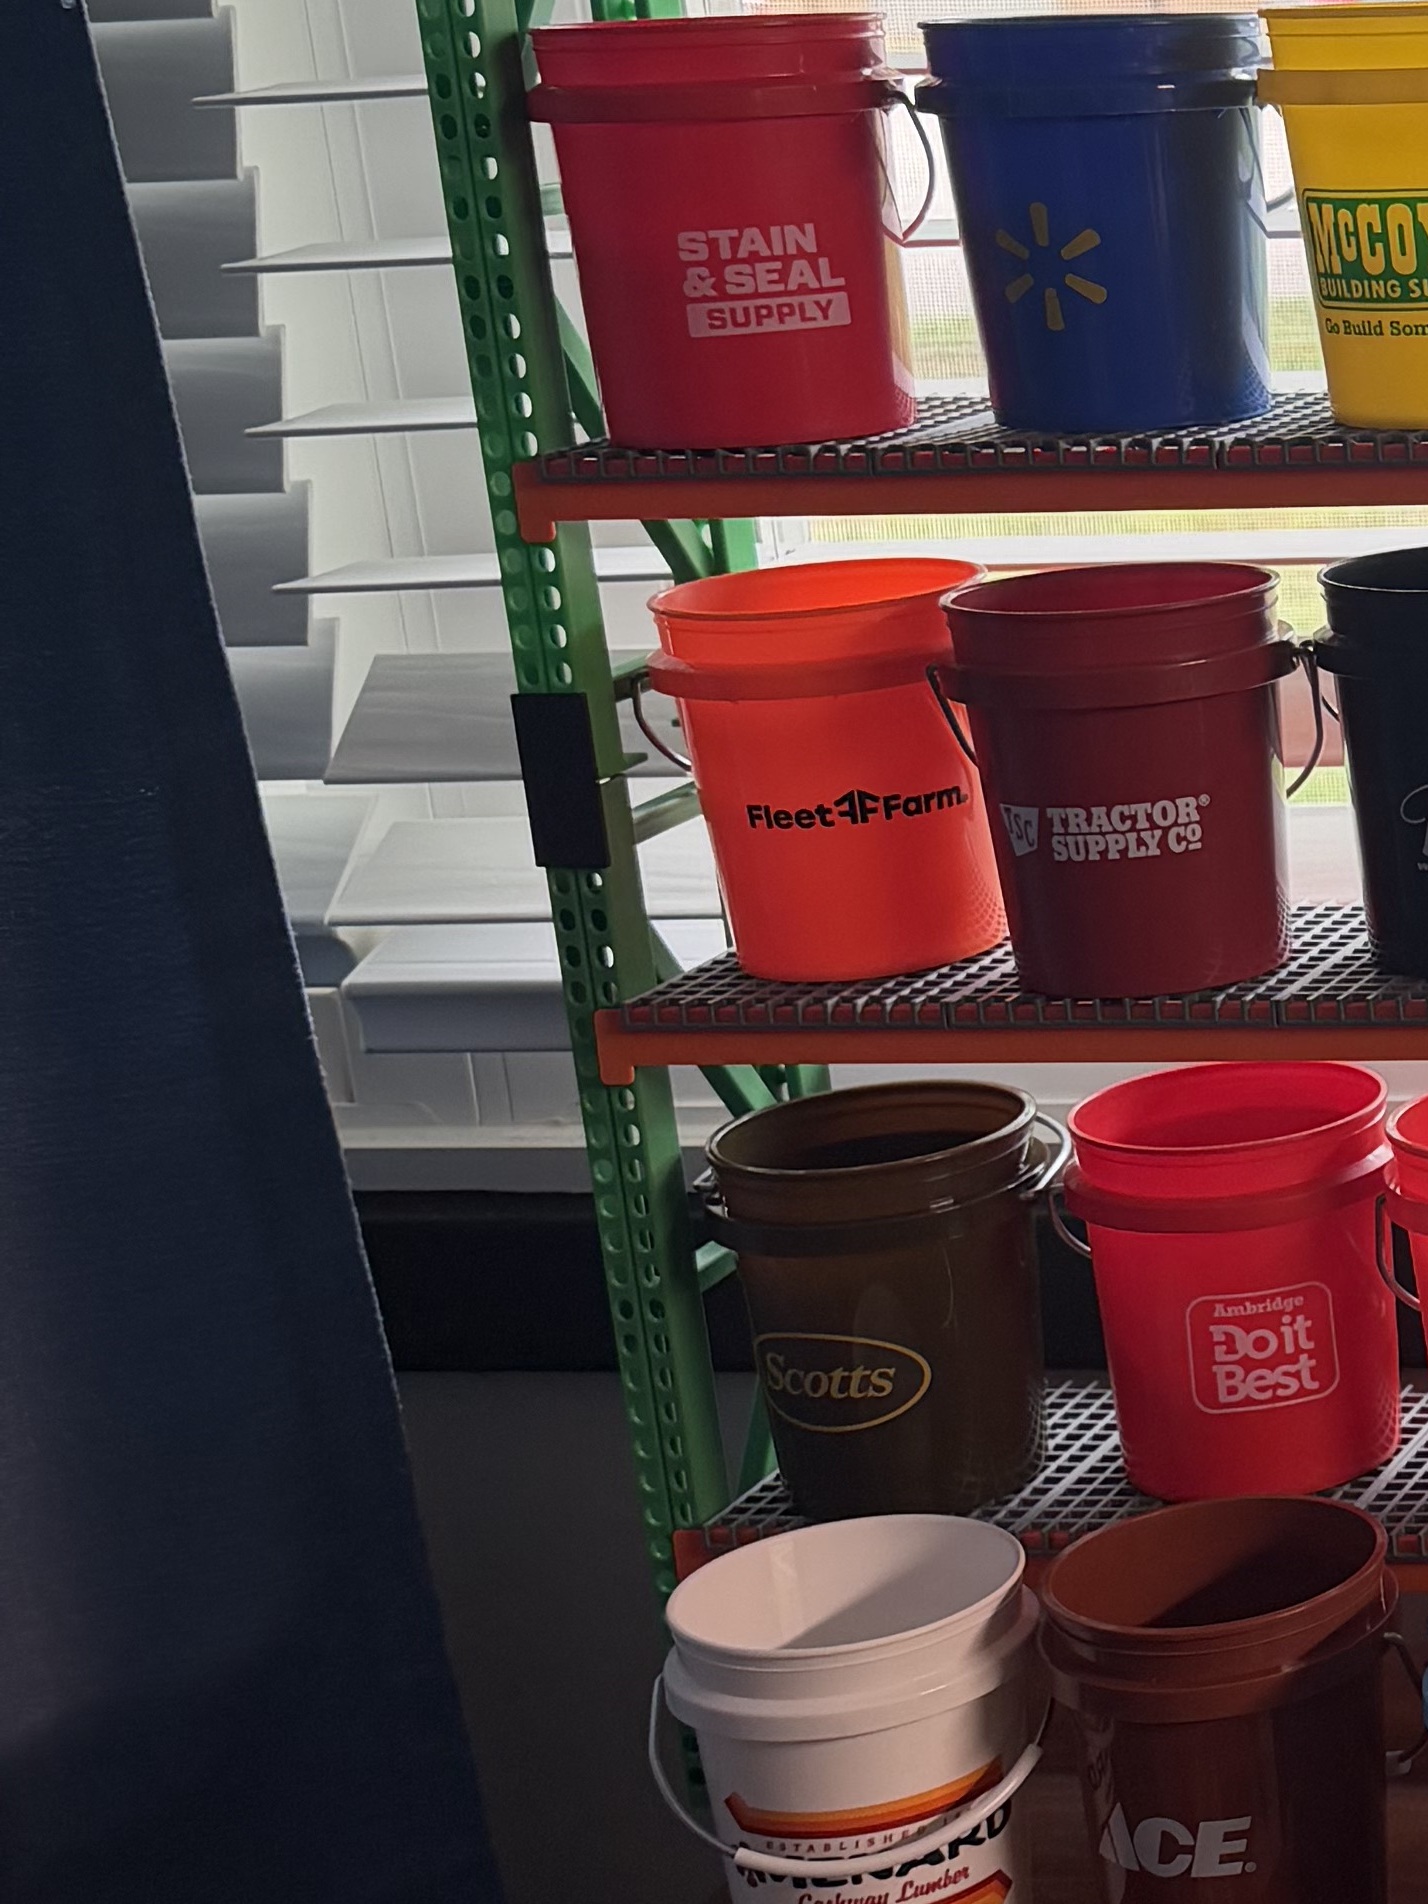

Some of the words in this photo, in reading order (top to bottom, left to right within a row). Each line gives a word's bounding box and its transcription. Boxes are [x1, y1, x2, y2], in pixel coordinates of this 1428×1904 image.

[677, 223, 818, 262] STAIN
[682, 267, 717, 297] &
[724, 257, 846, 295] SEAL
[1319, 278, 1403, 300] BUILDING
[707, 298, 835, 330] SUPPLY
[1324, 317, 1342, 335] Go
[1342, 317, 1385, 337] Build
[745, 803, 836, 831] Fleet
[882, 785, 961, 820] Farm
[1047, 796, 1201, 834] TRACTOR
[1052, 831, 1161, 864] SUPPLY
[1213, 1294, 1305, 1317] Ambridge
[1208, 1322, 1278, 1363] Do
[1281, 1313, 1315, 1356] it
[766, 1352, 896, 1400] Scotts
[1213, 1352, 1320, 1404] Best
[1099, 1801, 1252, 1879] ACE
[896, 1866, 970, 1904] Lumber
